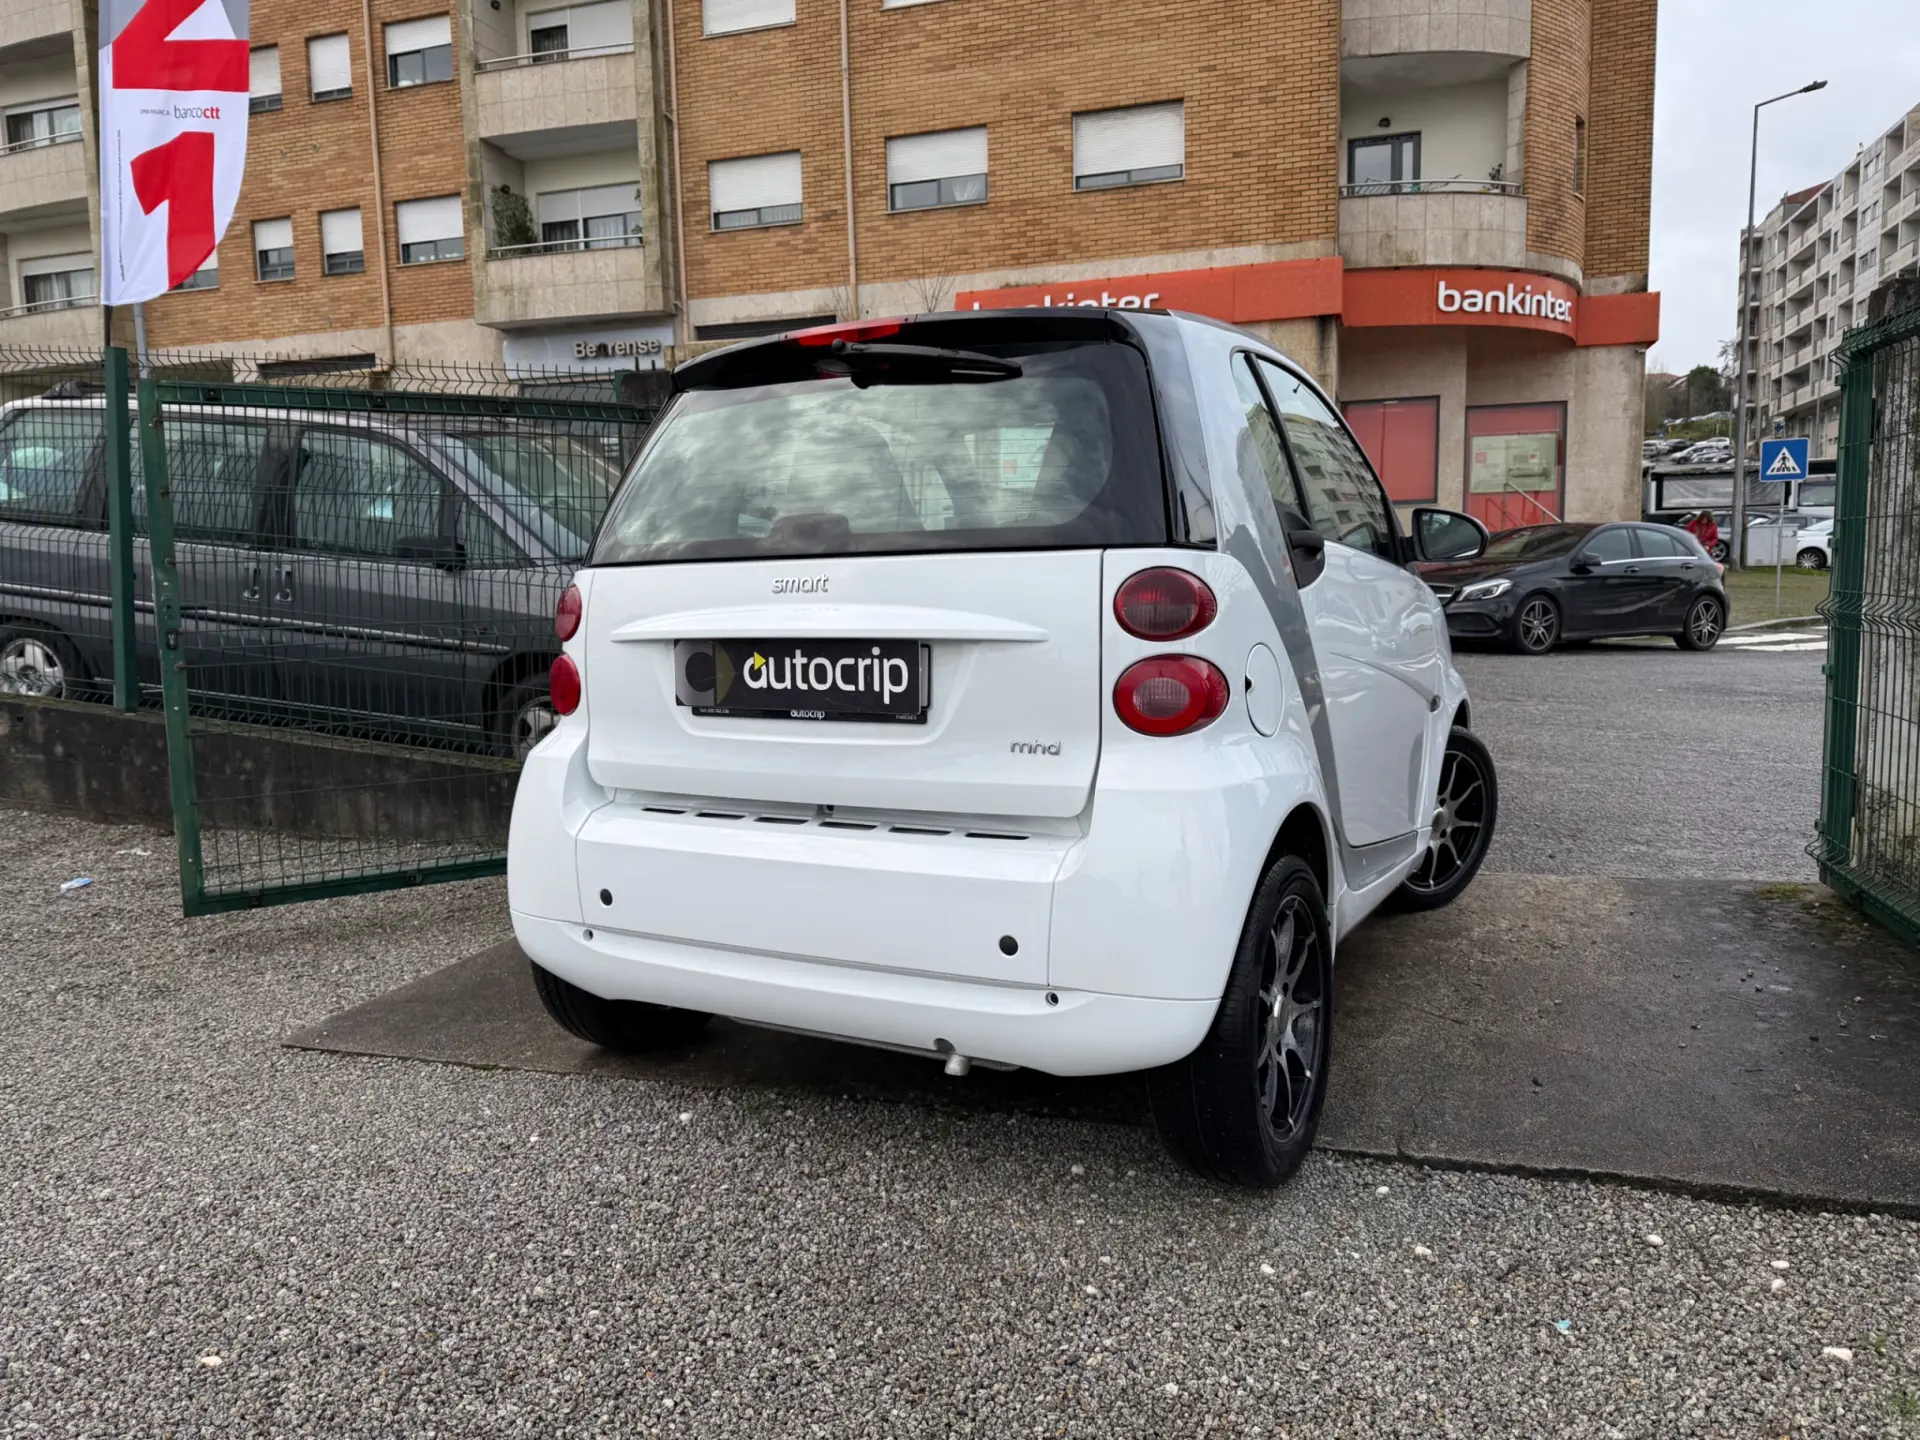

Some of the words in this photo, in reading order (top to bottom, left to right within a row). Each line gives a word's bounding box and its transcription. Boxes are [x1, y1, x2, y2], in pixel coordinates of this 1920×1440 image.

[771, 574, 829, 595] smart
[742, 645, 909, 705] autocrip
[790, 708, 825, 720] autocrip
